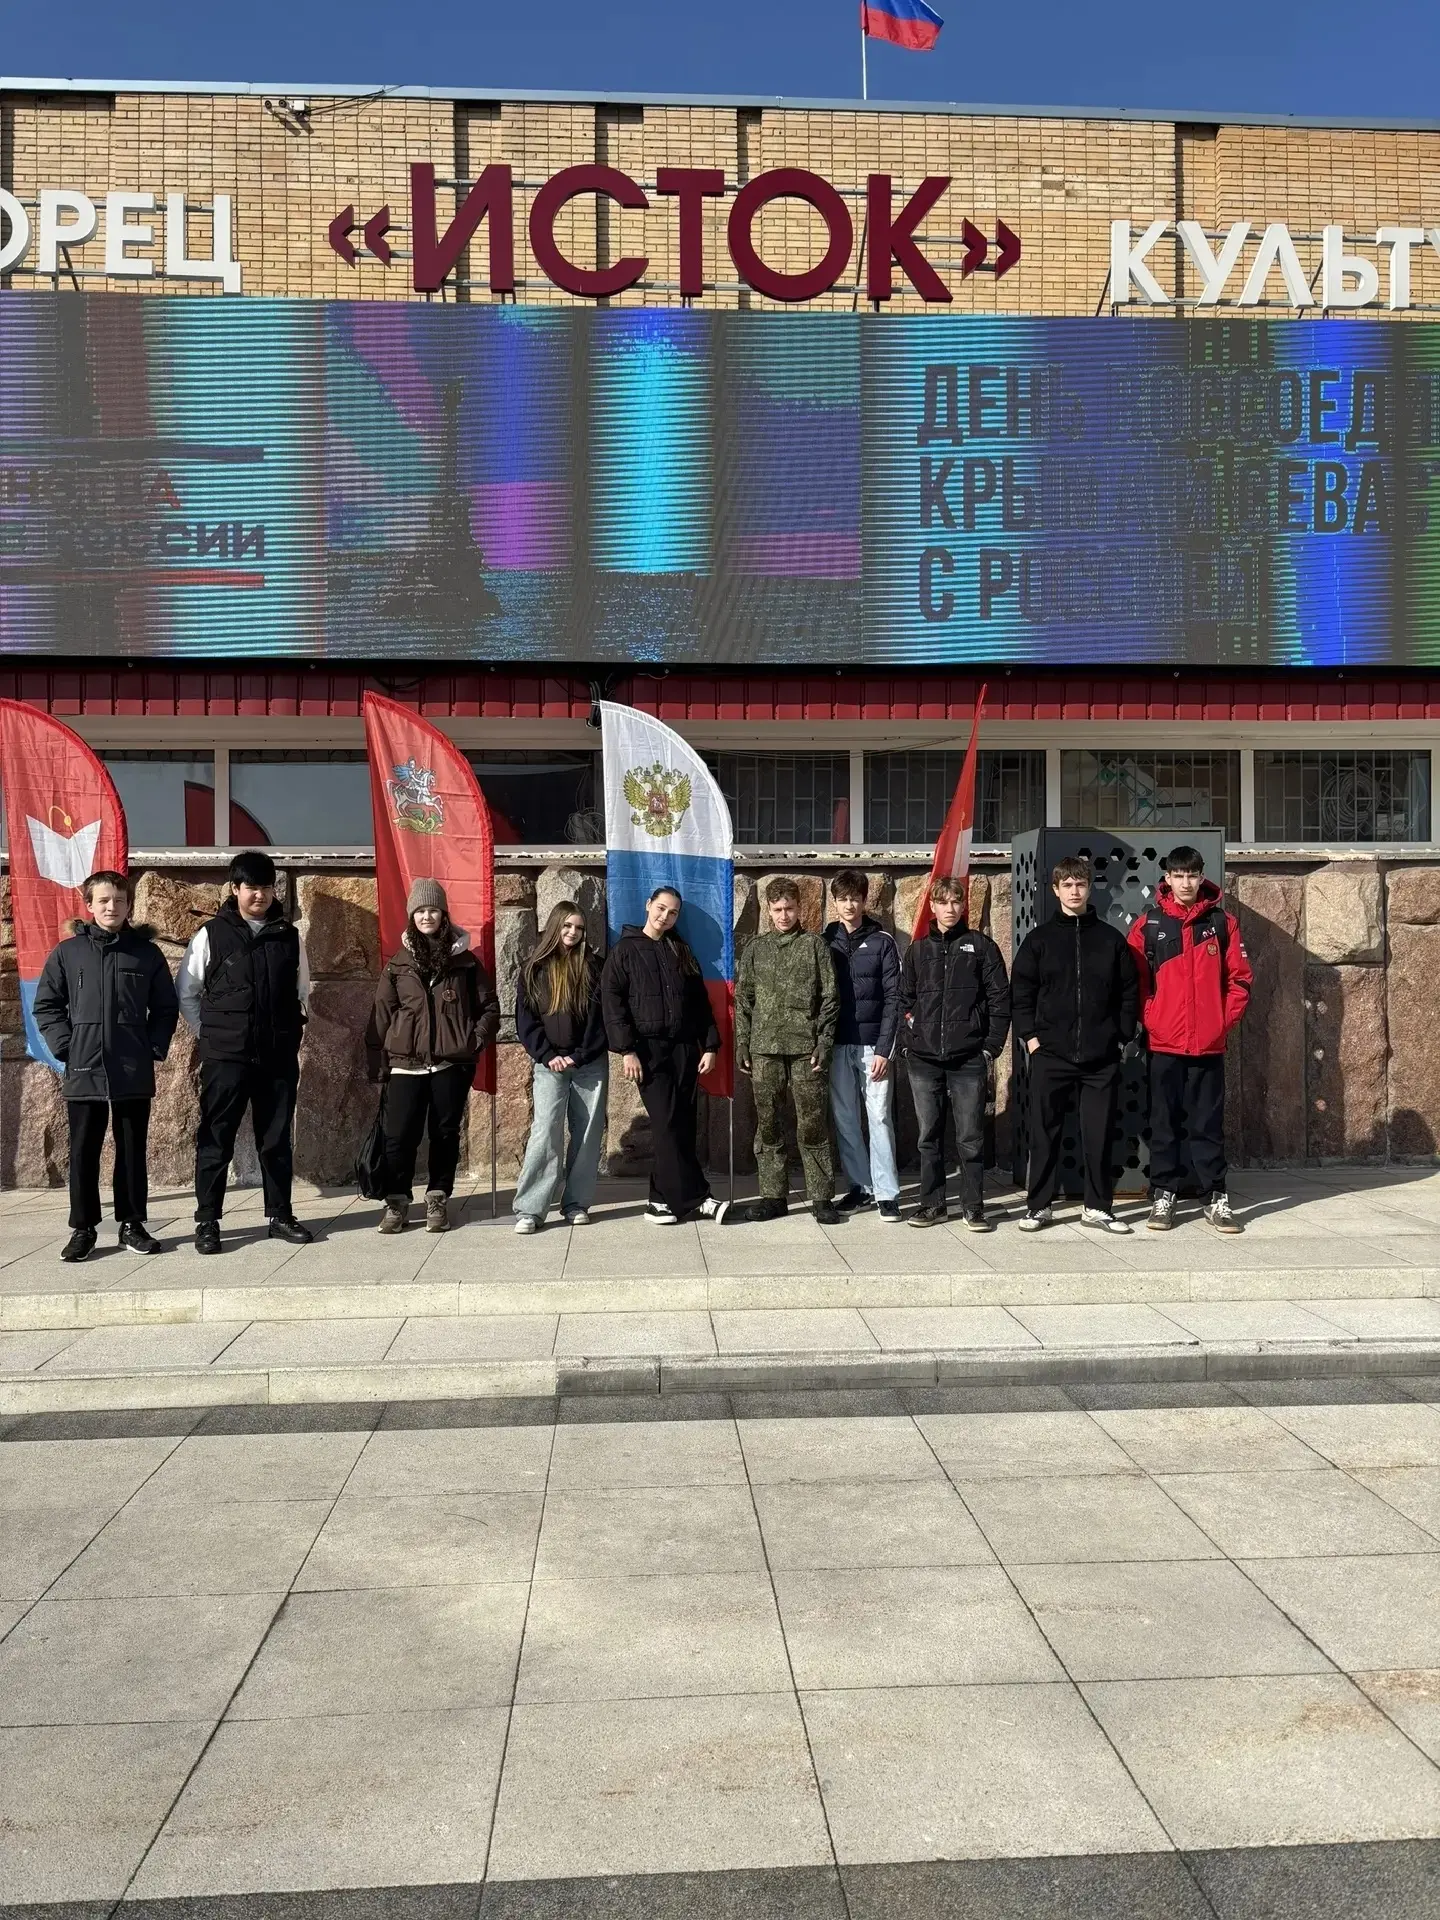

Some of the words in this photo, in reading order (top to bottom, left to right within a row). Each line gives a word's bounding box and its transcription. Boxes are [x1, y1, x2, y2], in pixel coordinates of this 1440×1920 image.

[329, 163, 1021, 303] «ИСТОК»
[1110, 219, 1440, 311] КУЛЬТ
[919, 548, 954, 622] С
